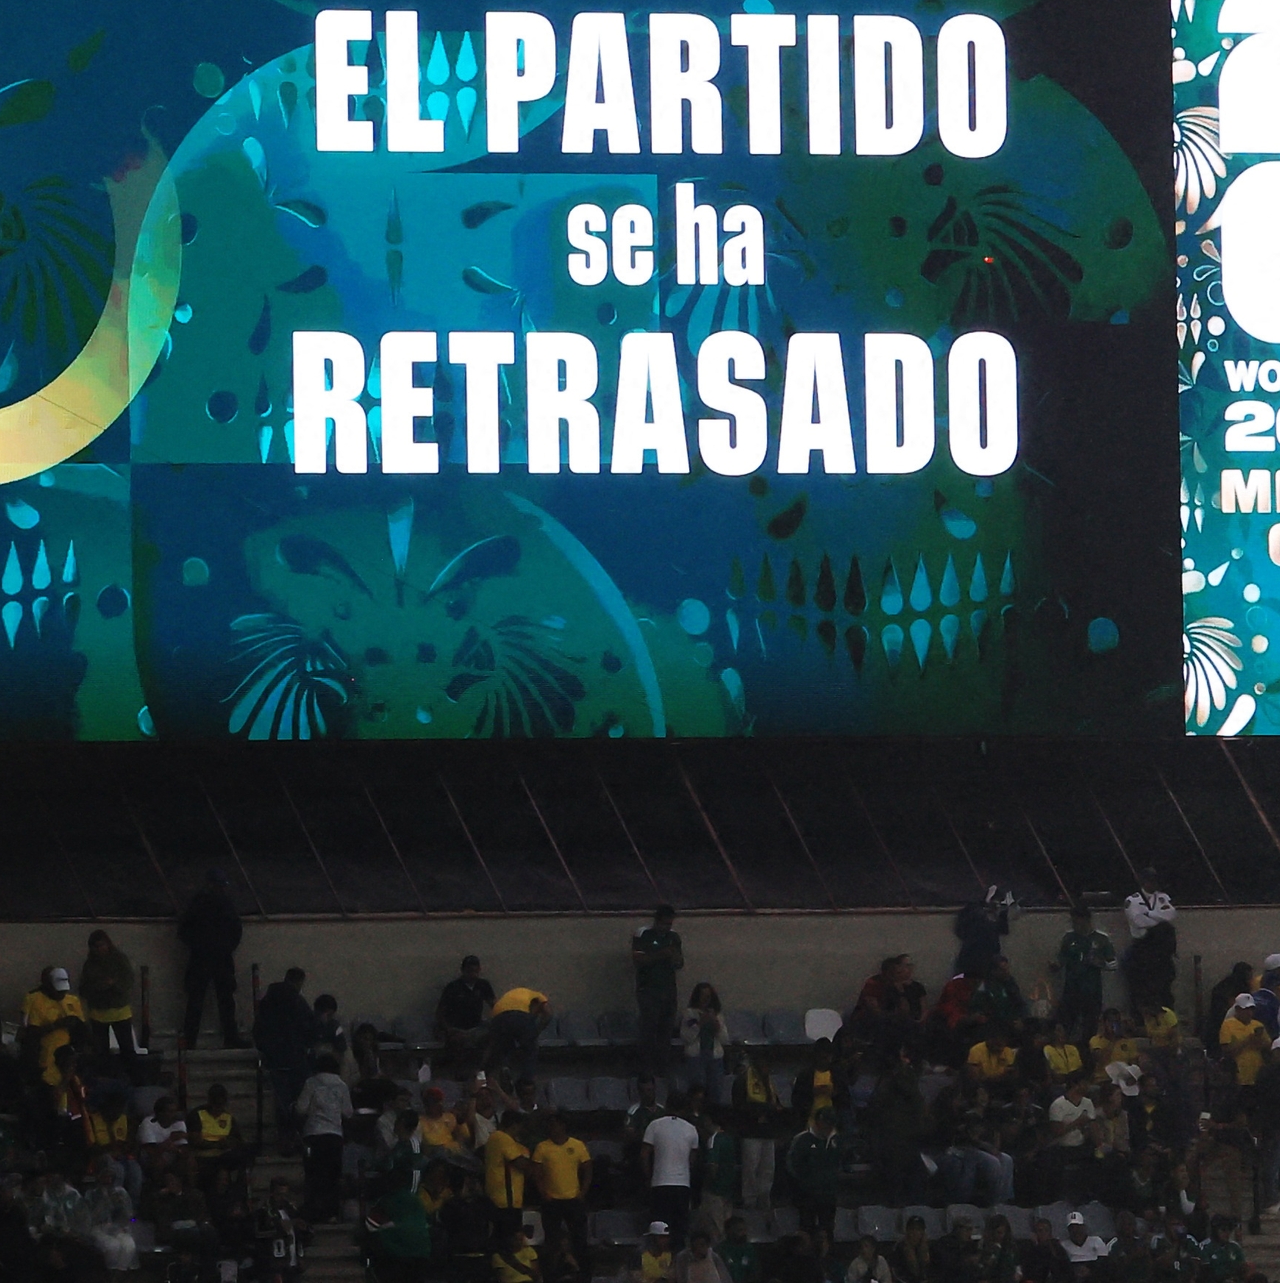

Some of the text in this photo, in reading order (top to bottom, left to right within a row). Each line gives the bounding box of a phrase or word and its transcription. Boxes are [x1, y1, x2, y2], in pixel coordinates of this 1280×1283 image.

[314, 9, 1007, 159] EL PARTIDO
[566, 182, 766, 287] se ha
[292, 330, 1019, 477] RETRASADO
